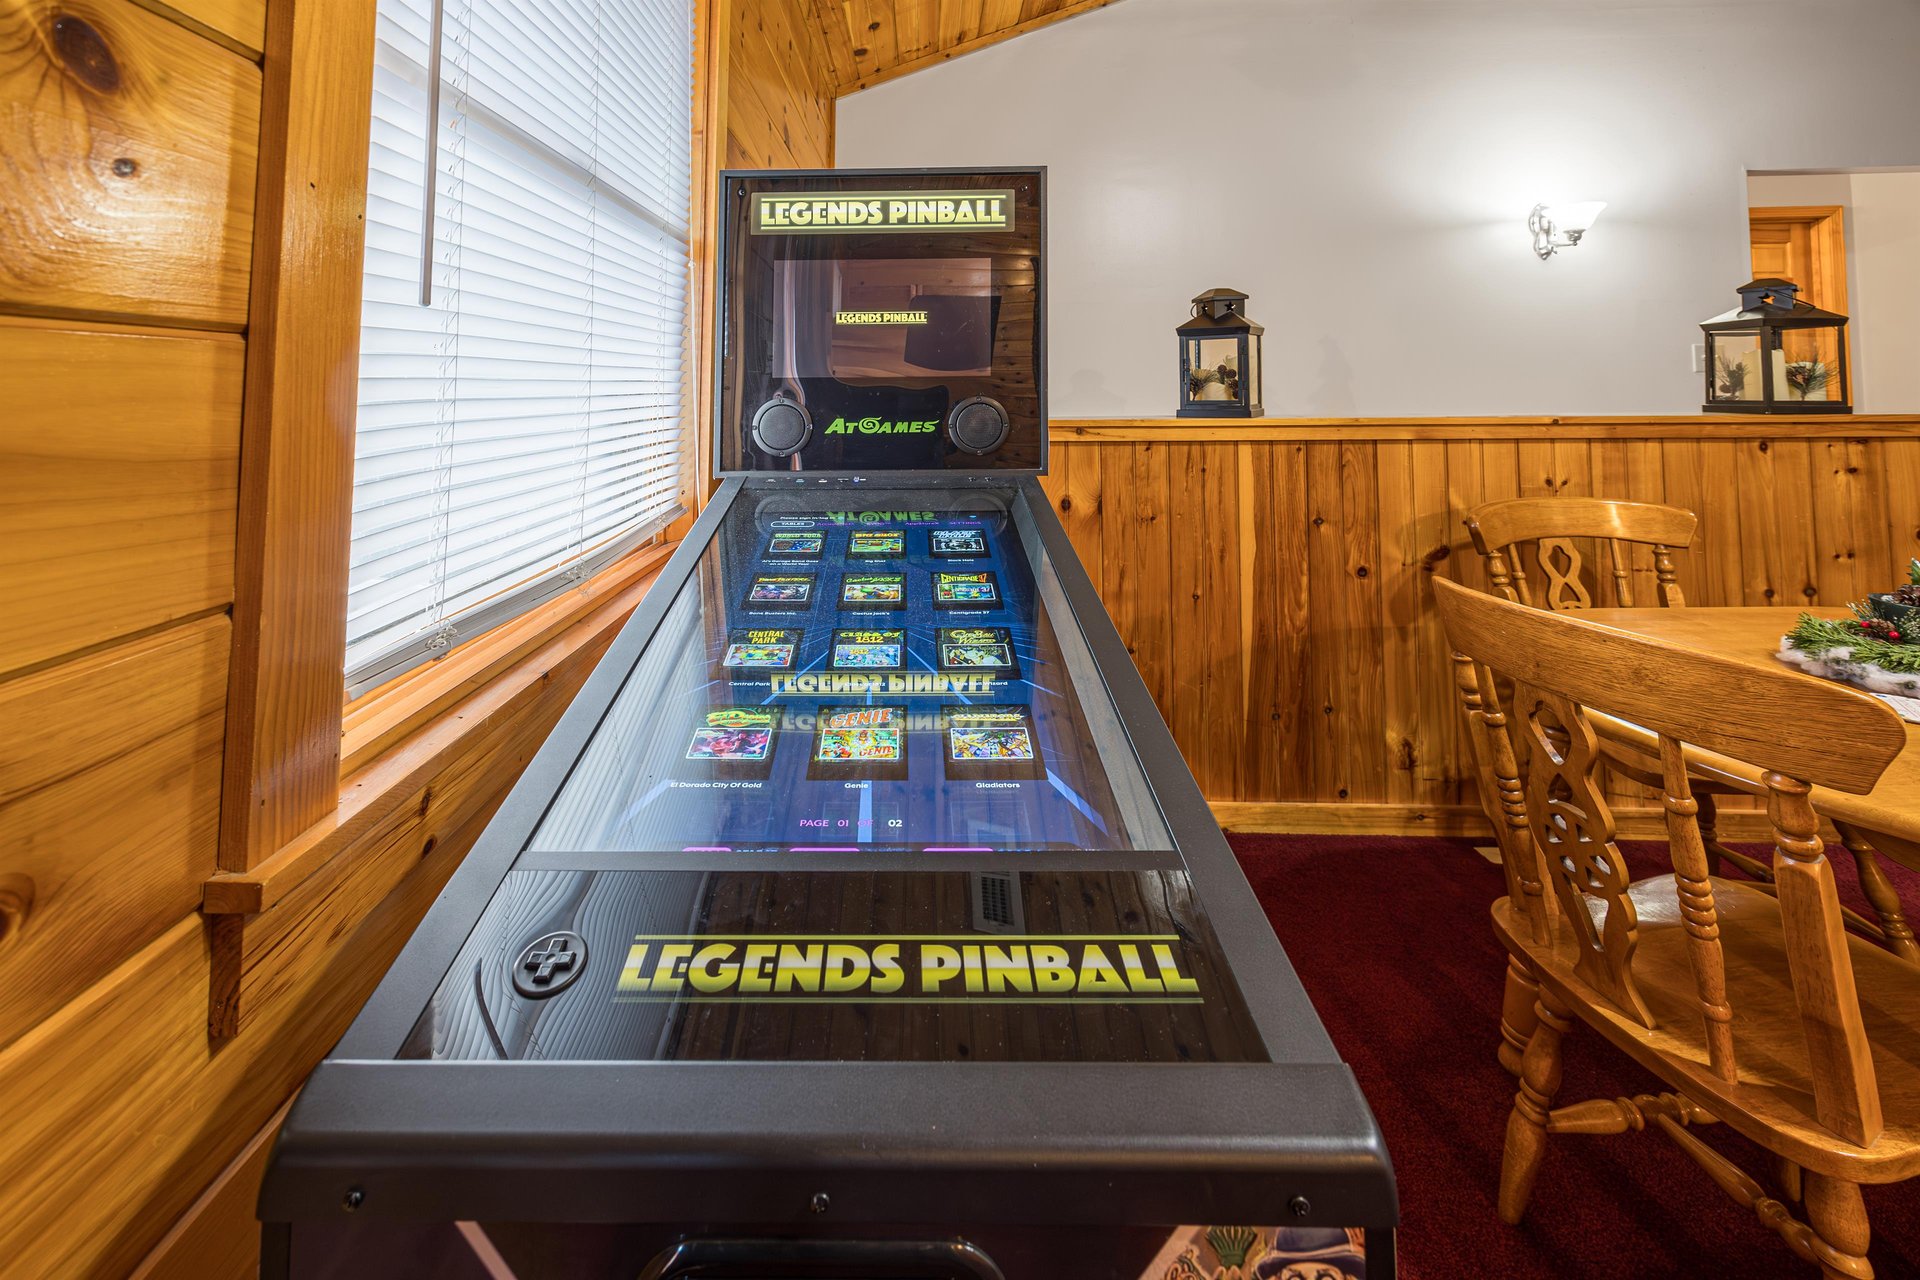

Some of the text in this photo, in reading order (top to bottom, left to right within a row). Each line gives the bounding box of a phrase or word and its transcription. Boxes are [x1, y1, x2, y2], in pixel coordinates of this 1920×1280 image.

[761, 199, 1006, 225] LEGENDS PINBALL
[836, 312, 928, 323] LEGENDS PINBALL
[748, 630, 785, 638] CENTRAL
[830, 708, 892, 728] GENIE
[859, 746, 894, 756] GENIE
[800, 819, 830, 827] PAGE
[837, 819, 849, 827] 01
[888, 819, 903, 827] 02
[616, 943, 1200, 993] LEGENDS PINBALL
